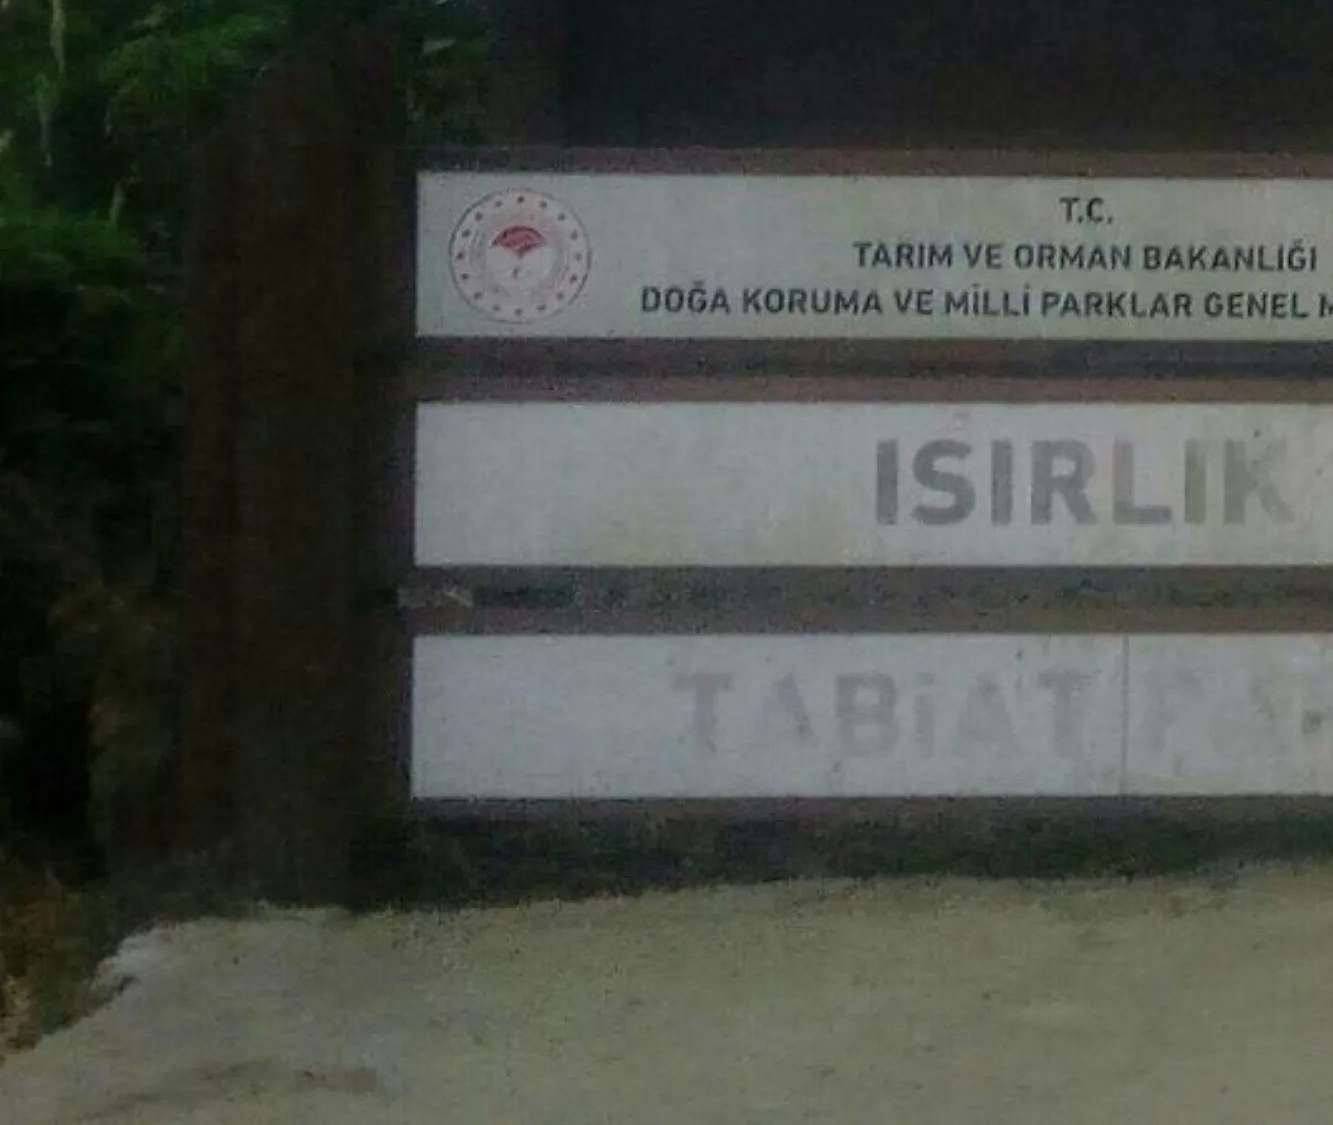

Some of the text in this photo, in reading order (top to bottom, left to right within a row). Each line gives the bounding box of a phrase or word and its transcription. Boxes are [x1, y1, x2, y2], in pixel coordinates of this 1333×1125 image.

[1060, 196, 1113, 223] T.C.
[854, 238, 1317, 272] TARIM VE ORMAN BAKANLIĞI
[640, 278, 730, 315] DOĞA
[742, 286, 882, 316] KORUMA
[893, 287, 934, 316] VE
[944, 281, 1032, 317] MİLLİ
[1041, 287, 1193, 319] PARKLAR
[1203, 292, 1308, 320] GENEL
[873, 438, 1295, 527] ISIRLIK
